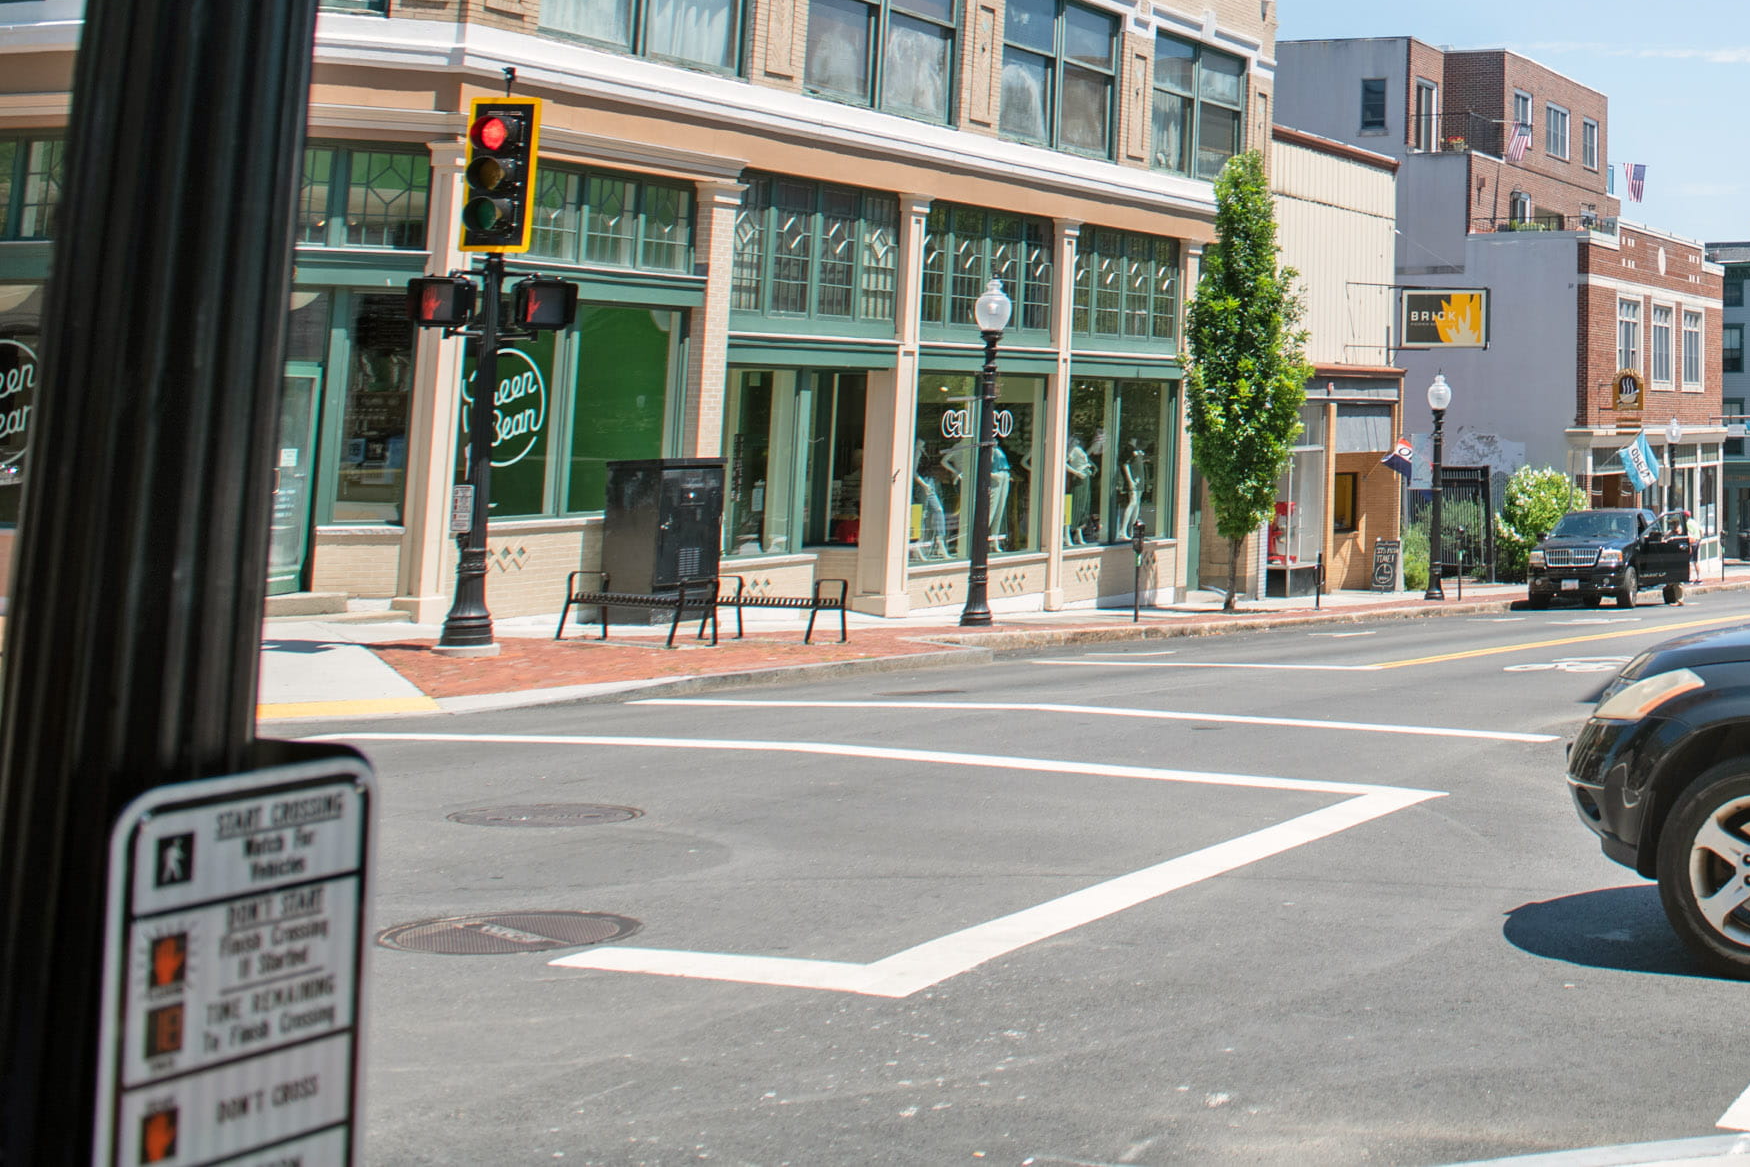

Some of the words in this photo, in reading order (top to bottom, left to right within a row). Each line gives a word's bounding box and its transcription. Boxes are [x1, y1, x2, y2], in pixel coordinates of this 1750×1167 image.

[1411, 311, 1456, 321] BRICK
[217, 807, 261, 838] START
[272, 792, 344, 826] CROSSING
[282, 885, 325, 913] START
[272, 1075, 319, 1107] CROSS
